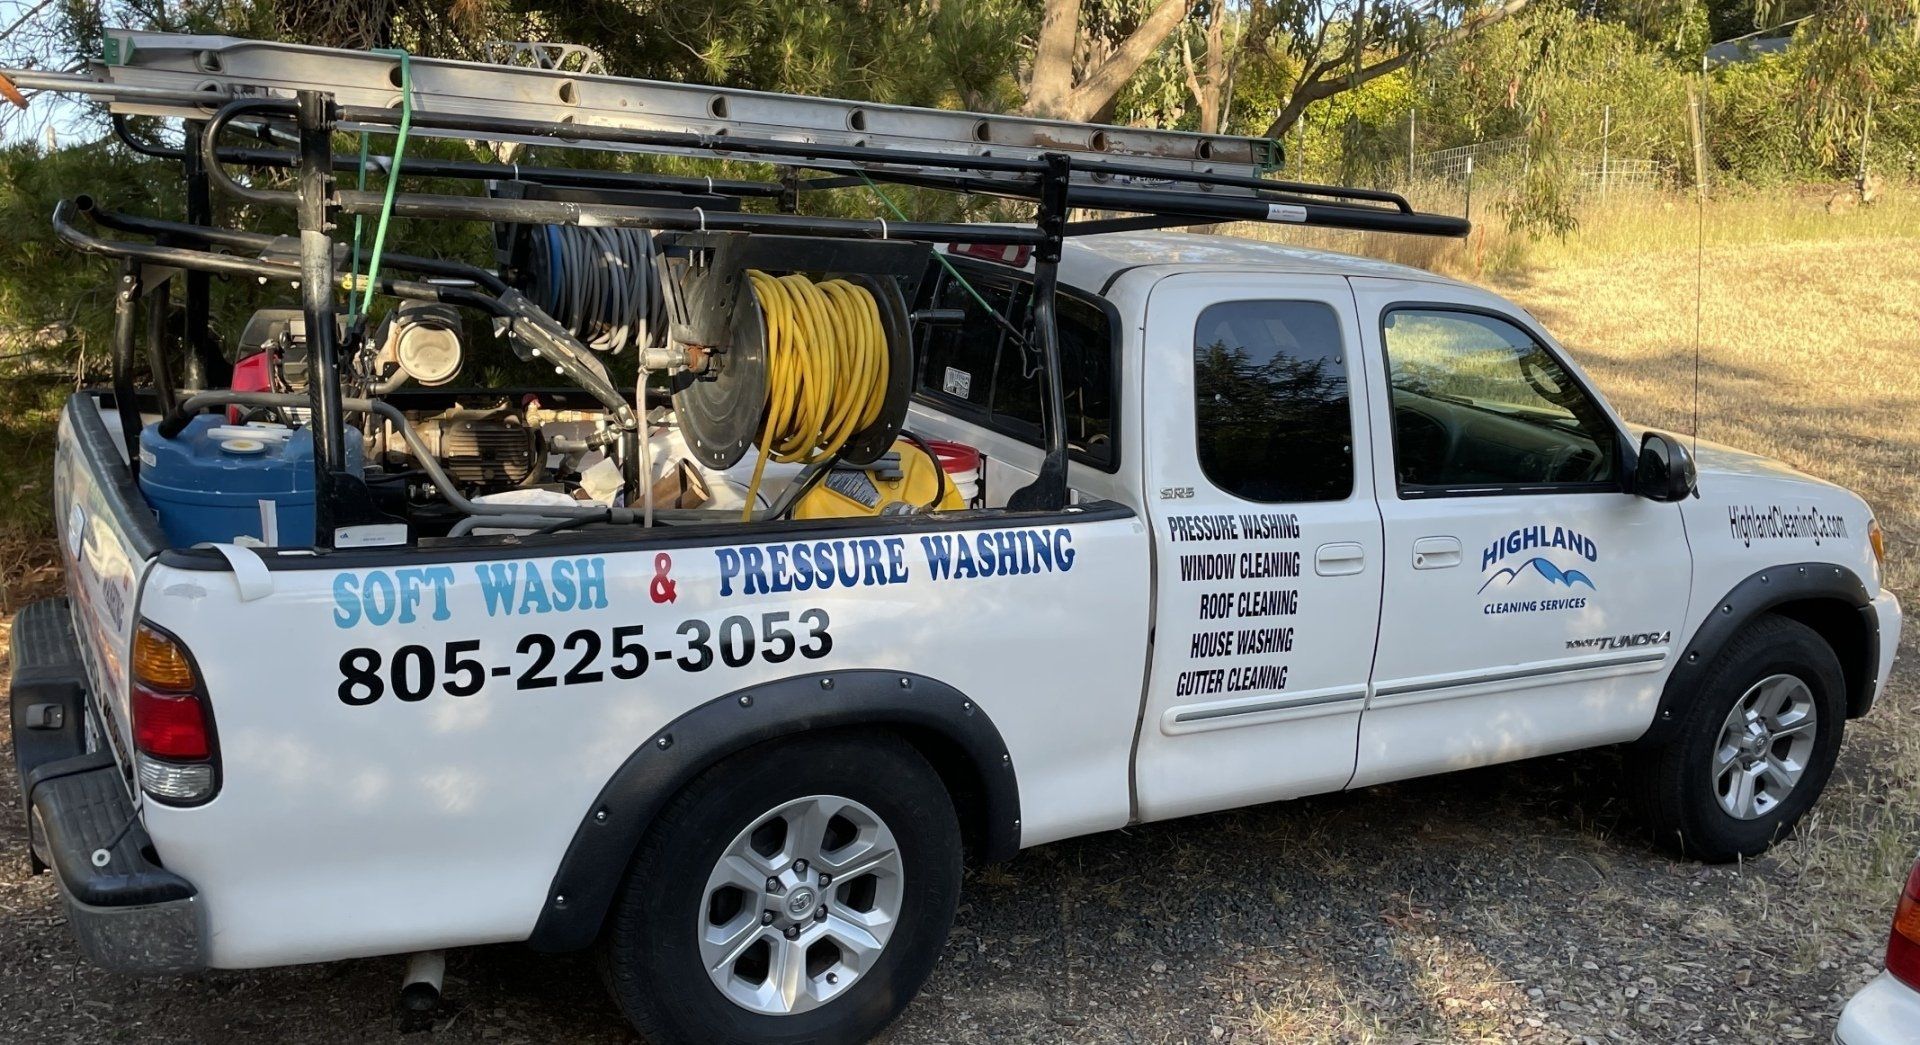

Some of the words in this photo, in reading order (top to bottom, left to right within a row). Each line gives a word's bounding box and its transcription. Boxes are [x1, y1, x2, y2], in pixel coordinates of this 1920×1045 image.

[1160, 487, 1195, 500] SR5
[1167, 515, 1238, 542] PRESSURE
[1239, 513, 1300, 540] WASHING
[1728, 505, 1848, 548] HighlandCleaningCa.com
[1481, 525, 1598, 573] HIGHLAND
[333, 566, 455, 629] SOFT
[475, 557, 609, 617] WASH
[650, 552, 677, 605] &
[715, 538, 909, 597] PRESSURE
[920, 528, 1076, 582] WASHING
[1180, 553, 1236, 582] WINDOW
[1240, 551, 1300, 579] CLEANING
[1199, 592, 1235, 620] ROOF
[1237, 589, 1298, 618] CLEANING
[1483, 600, 1537, 615] CLEANING
[1540, 597, 1587, 611] SERVICES
[1190, 630, 1234, 659] HOUSE
[1236, 627, 1294, 655] WASHING
[1596, 630, 1671, 651] TUNDRA
[337, 608, 833, 706] 805-225-3053
[1176, 667, 1225, 697] GUTTER
[1227, 665, 1289, 691] CLEANING
